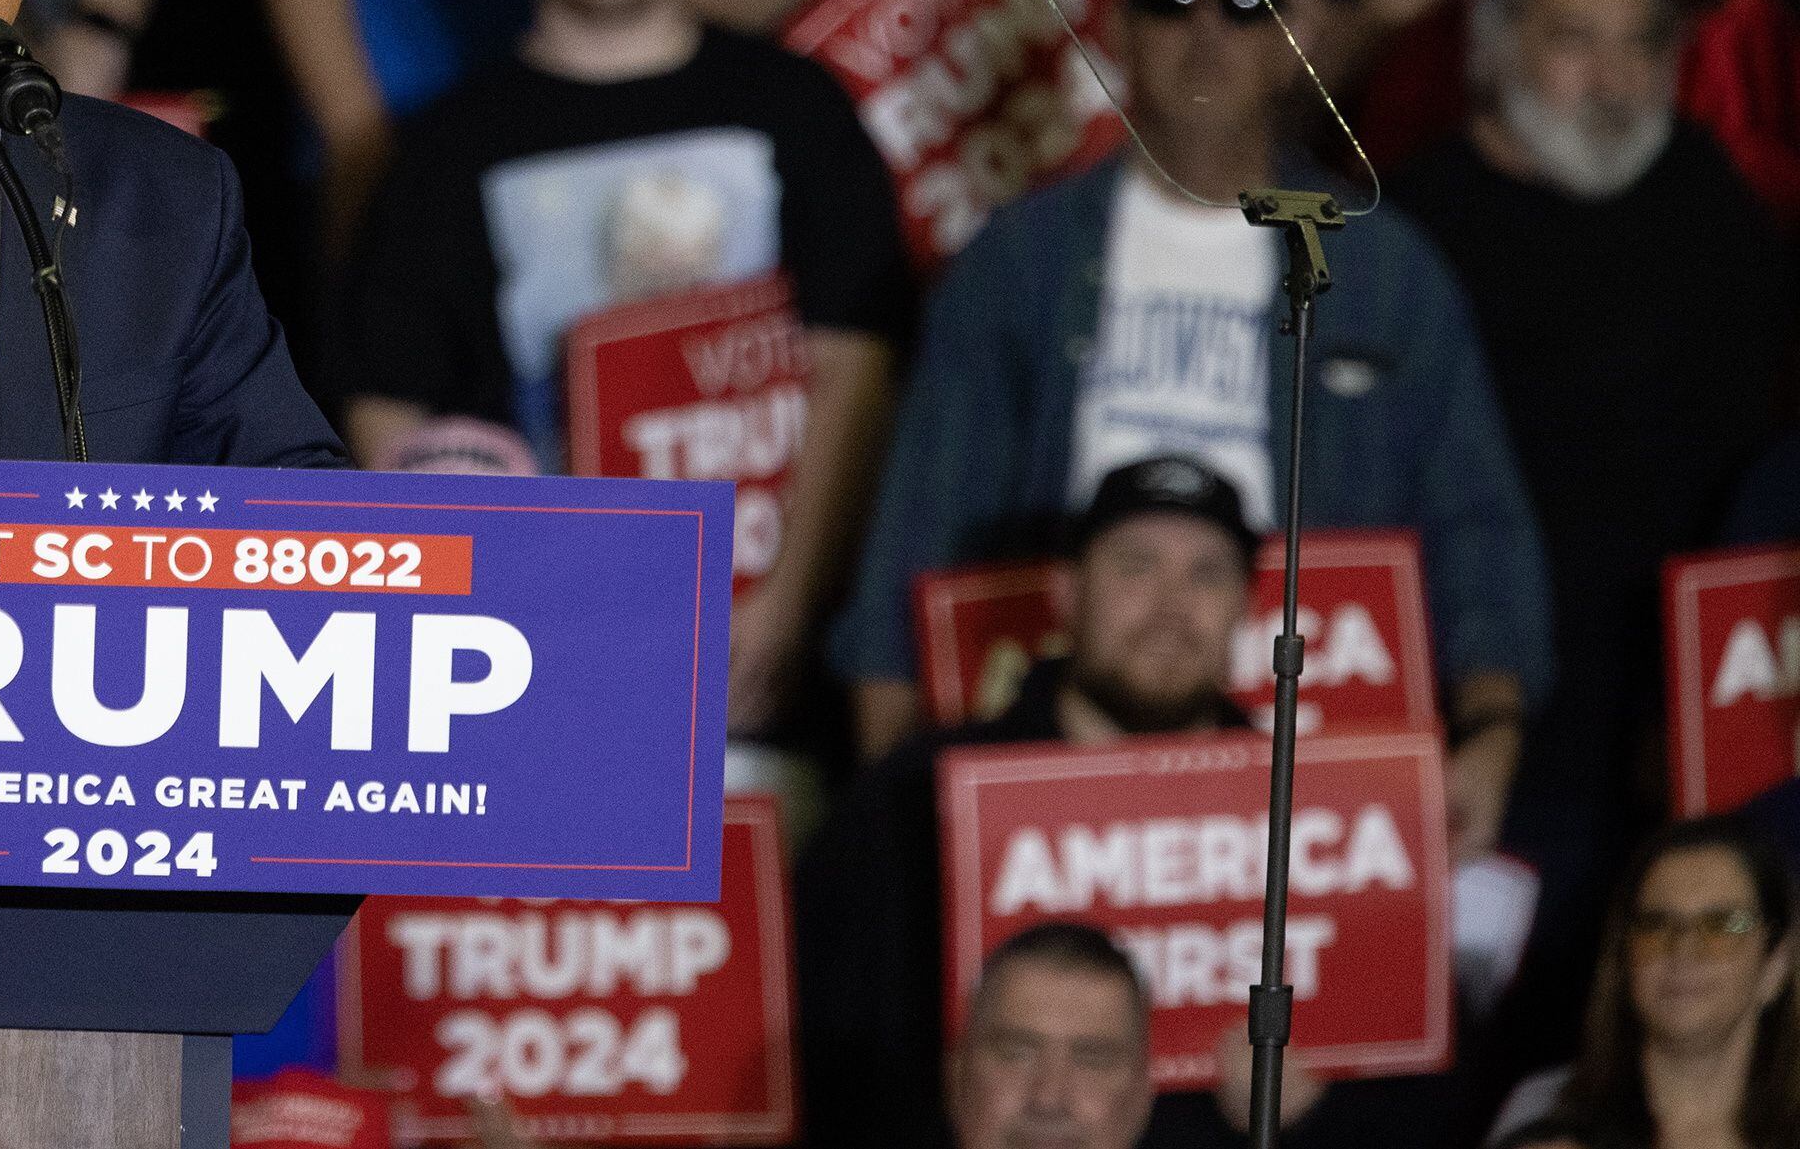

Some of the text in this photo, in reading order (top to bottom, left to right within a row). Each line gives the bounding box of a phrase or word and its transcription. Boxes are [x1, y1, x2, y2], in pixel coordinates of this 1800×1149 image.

[31, 531, 113, 580] SC
[132, 534, 213, 583] TO
[232, 536, 422, 588] 88022
[154, 775, 307, 811] GREAT
[323, 779, 488, 816] AGAIN!
[40, 826, 219, 878] 2024
[388, 907, 732, 1002] TRUMP
[433, 1004, 687, 1098] 2024
